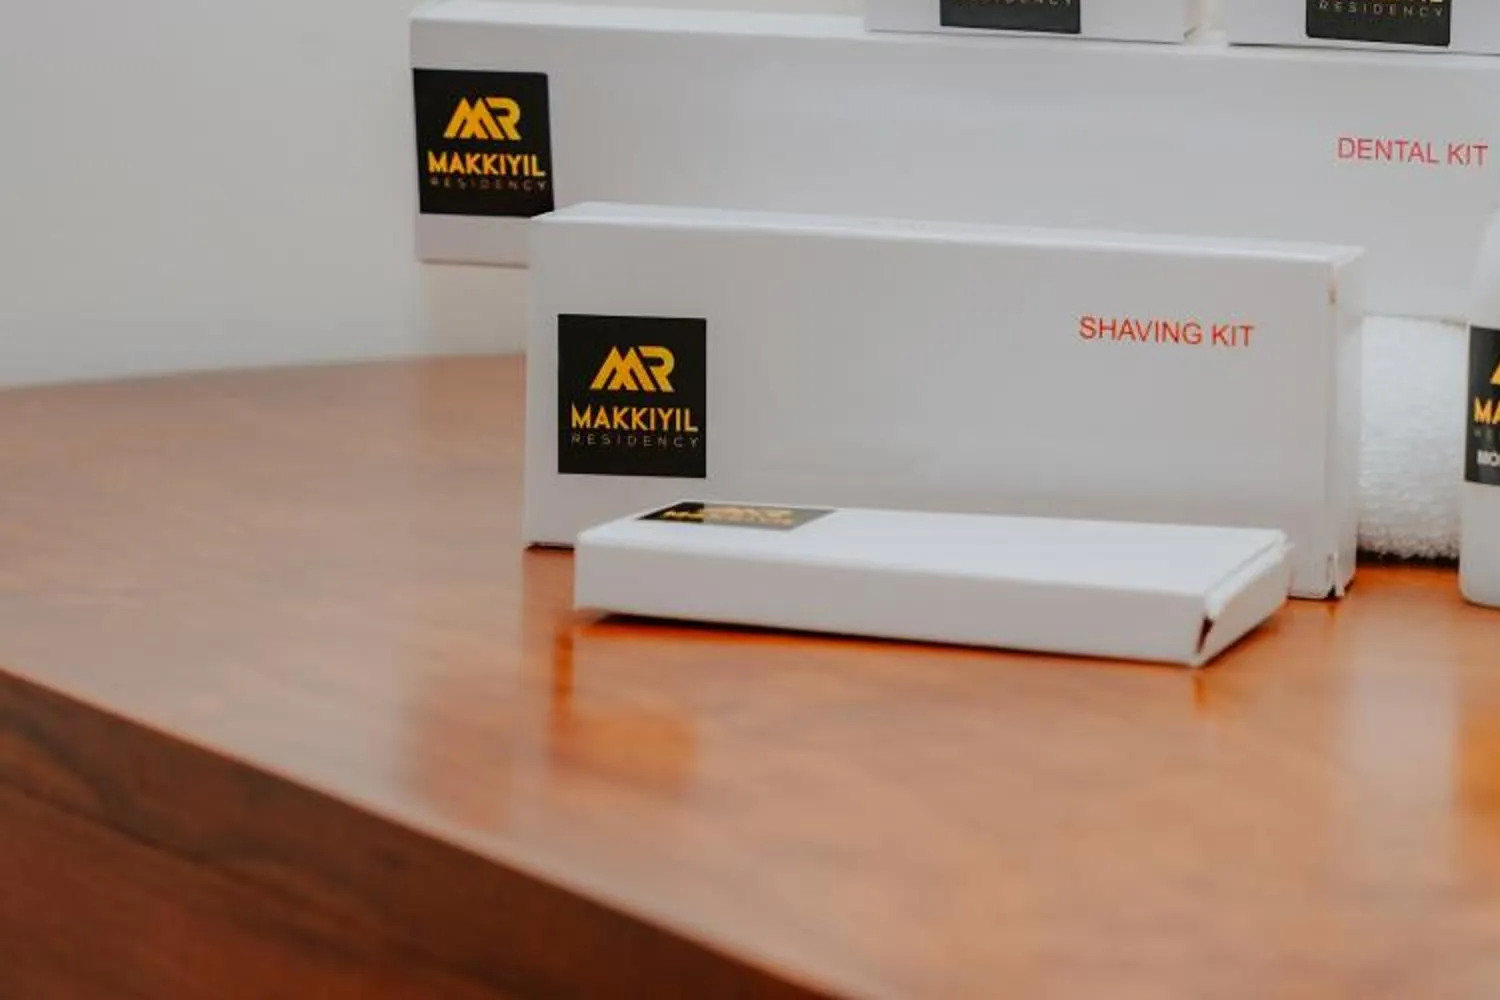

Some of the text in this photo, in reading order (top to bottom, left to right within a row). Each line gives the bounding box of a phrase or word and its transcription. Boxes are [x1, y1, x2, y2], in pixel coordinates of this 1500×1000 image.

[1319, 0, 1443, 18] RESIDENCY
[428, 149, 546, 177] MAKKIYIL
[1338, 137, 1488, 166] DENTAL KIT
[1079, 316, 1255, 347] SHAVING KIT
[571, 401, 698, 432] MAKKIYIL
[571, 433, 699, 448] RESIDENCY
